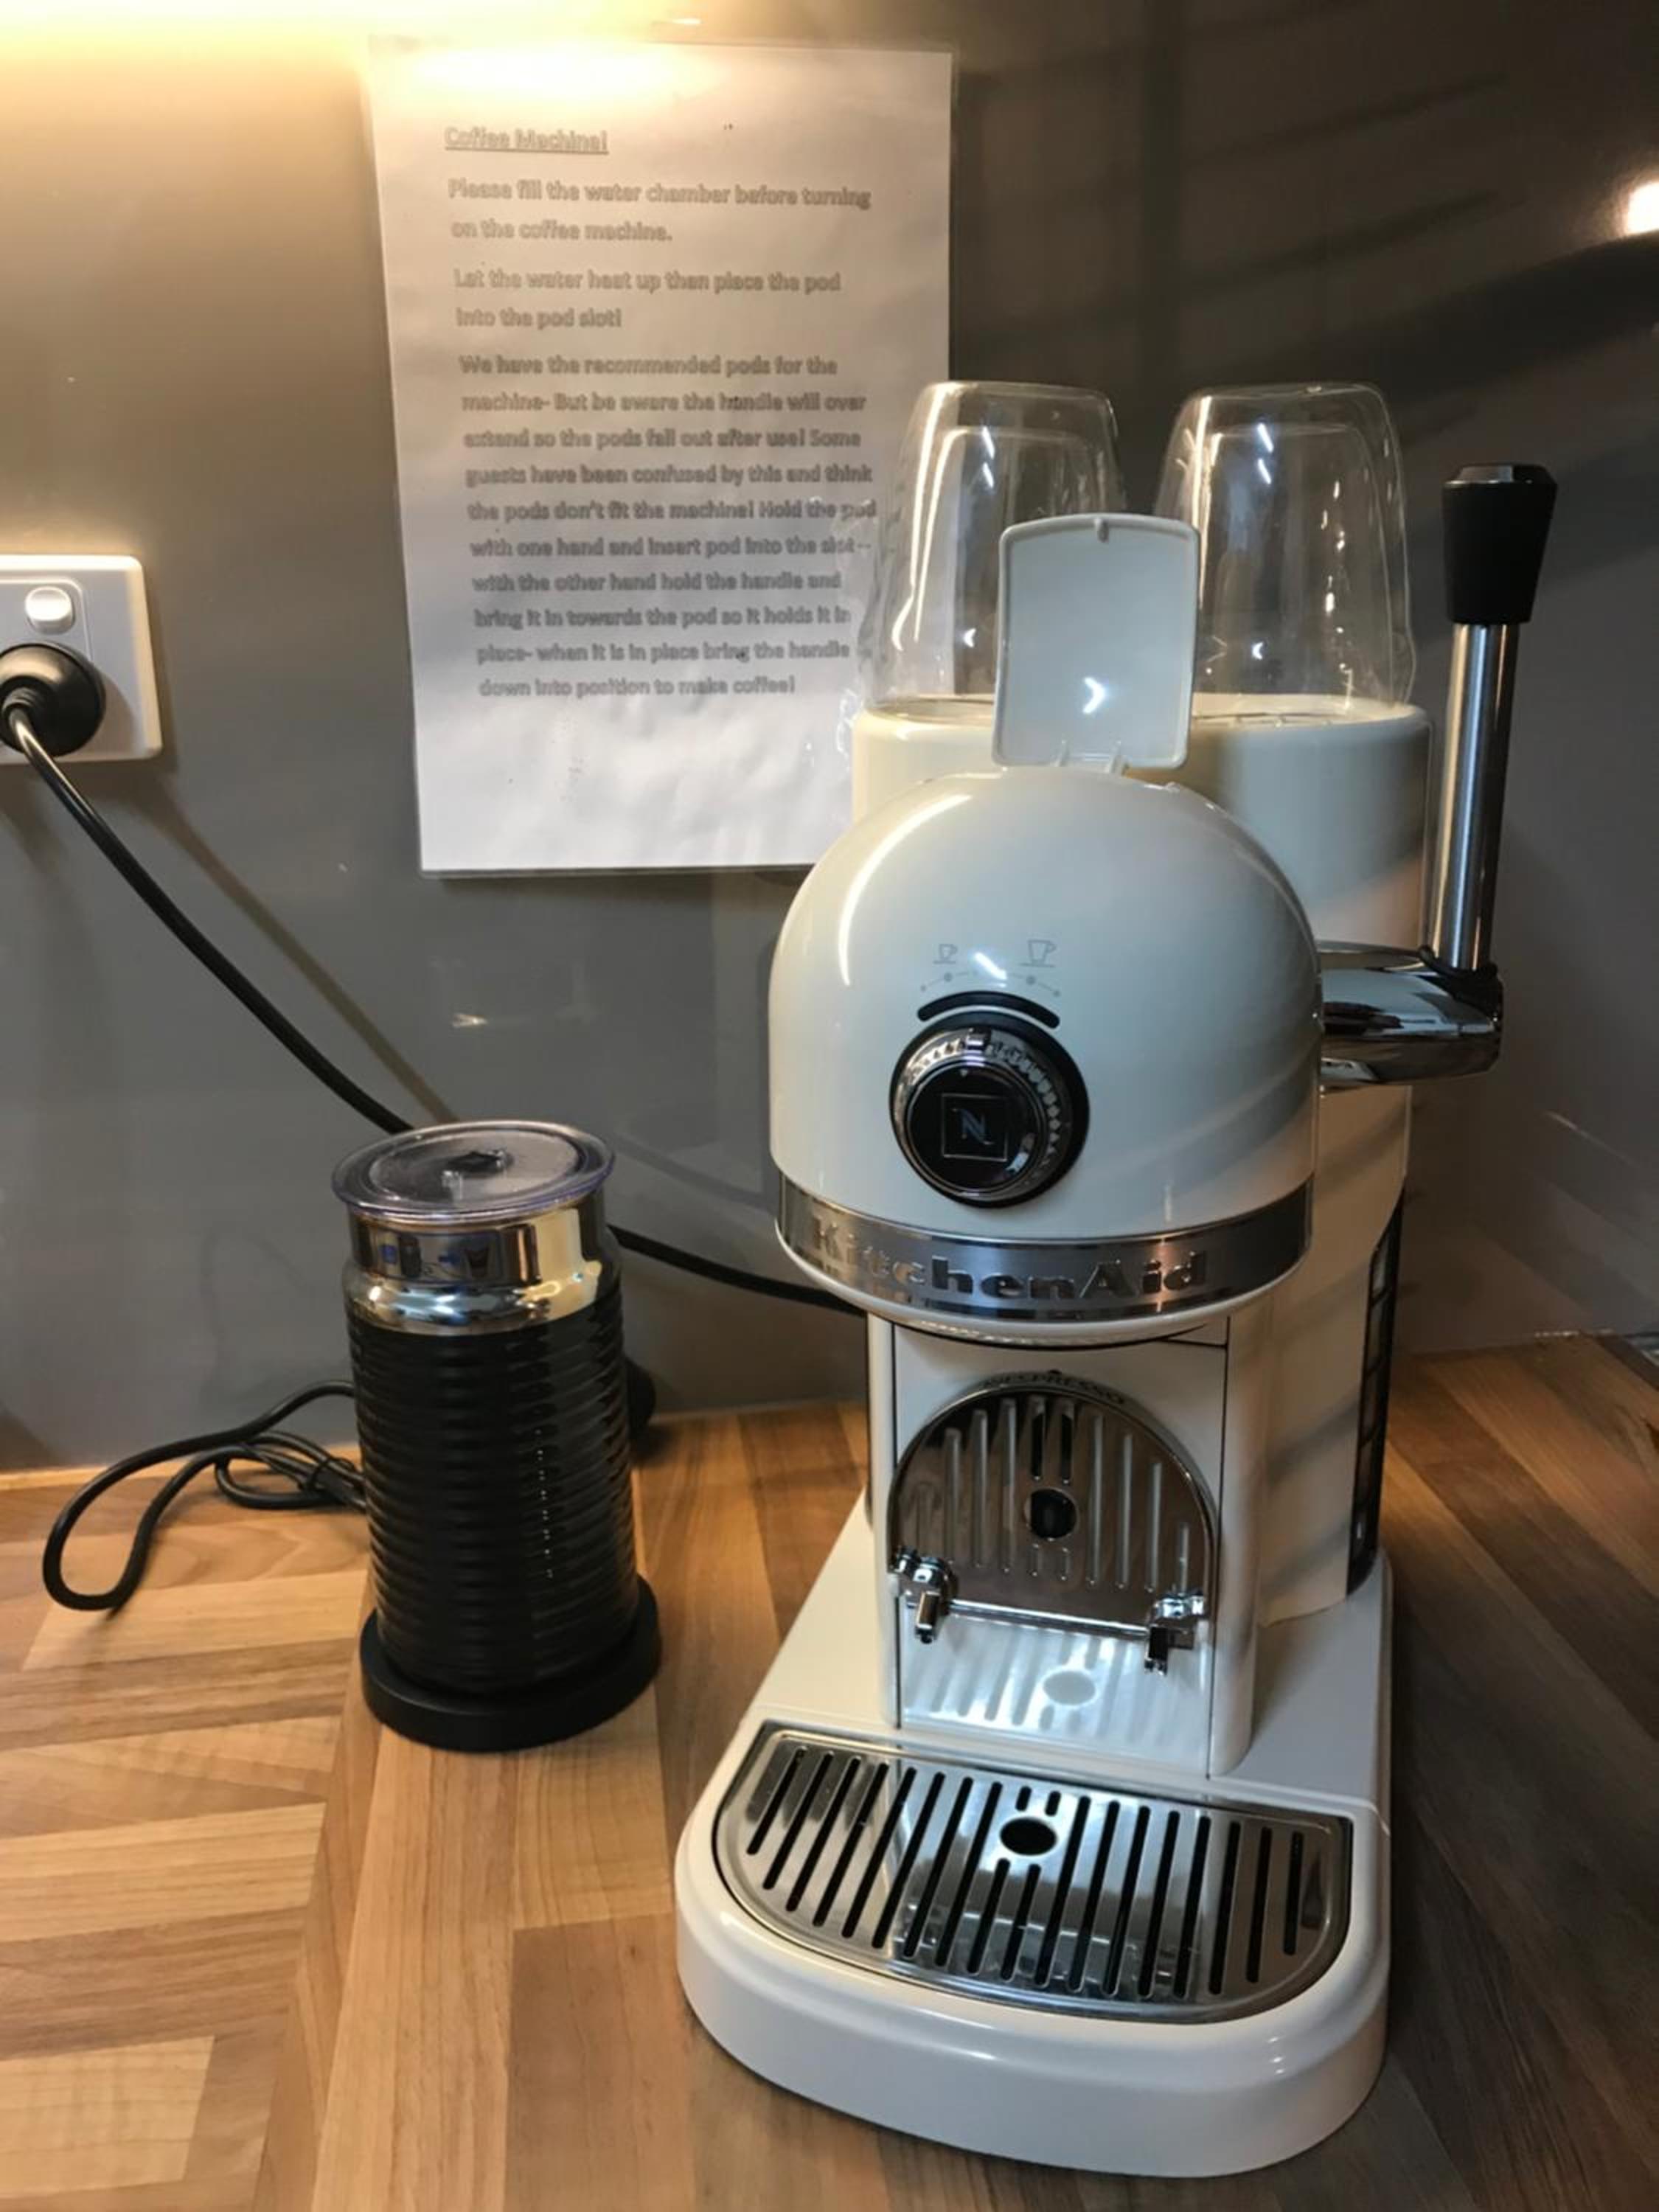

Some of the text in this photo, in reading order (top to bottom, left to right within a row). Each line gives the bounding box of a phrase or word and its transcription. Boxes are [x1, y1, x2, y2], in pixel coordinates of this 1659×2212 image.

[445, 128, 608, 150] Coffee Machine!
[448, 179, 872, 209] Please fill the water chamber before turning
[451, 220, 672, 241] on the coffee machine.
[454, 269, 484, 288] Let
[489, 269, 521, 288] the
[526, 271, 583, 289] water
[589, 271, 630, 289] heat
[636, 274, 661, 293] up
[714, 271, 763, 293] place
[768, 271, 799, 291] the
[804, 271, 841, 294] pod
[456, 308, 622, 330] into the pod slot!
[459, 356, 837, 378] We have the recommended pods for the
[554, 393, 588, 411] But
[592, 393, 616, 411] be
[621, 396, 678, 411] aware
[683, 393, 714, 411] the
[719, 393, 782, 411] handle
[787, 393, 819, 411] will
[824, 396, 866, 411] over
[463, 429, 860, 450] extend so the pods fall out after use! Some
[465, 465, 872, 487] guests have been confused by this and think
[468, 501, 875, 523] the pods don't fit the machine! Hold the pod
[470, 540, 512, 557] with
[518, 542, 552, 557] one
[557, 539, 603, 556] hand
[609, 538, 644, 555] and
[648, 538, 700, 555] insert
[706, 538, 740, 557] pod
[745, 537, 782, 554] into
[786, 536, 816, 554] the
[473, 571, 841, 591] with the other hand hold the handle and
[474, 606, 851, 630] bring it in towards the pod so it holds it in
[538, 644, 588, 661] when
[592, 644, 605, 661] it
[611, 644, 625, 661] is
[629, 644, 646, 661] in
[650, 644, 698, 664] place
[703, 642, 749, 663] bring
[755, 641, 785, 659] the
[789, 641, 850, 658] handle
[479, 676, 795, 698] down into position to make coffee!
[813, 1215, 1208, 1299] KitchenAid
